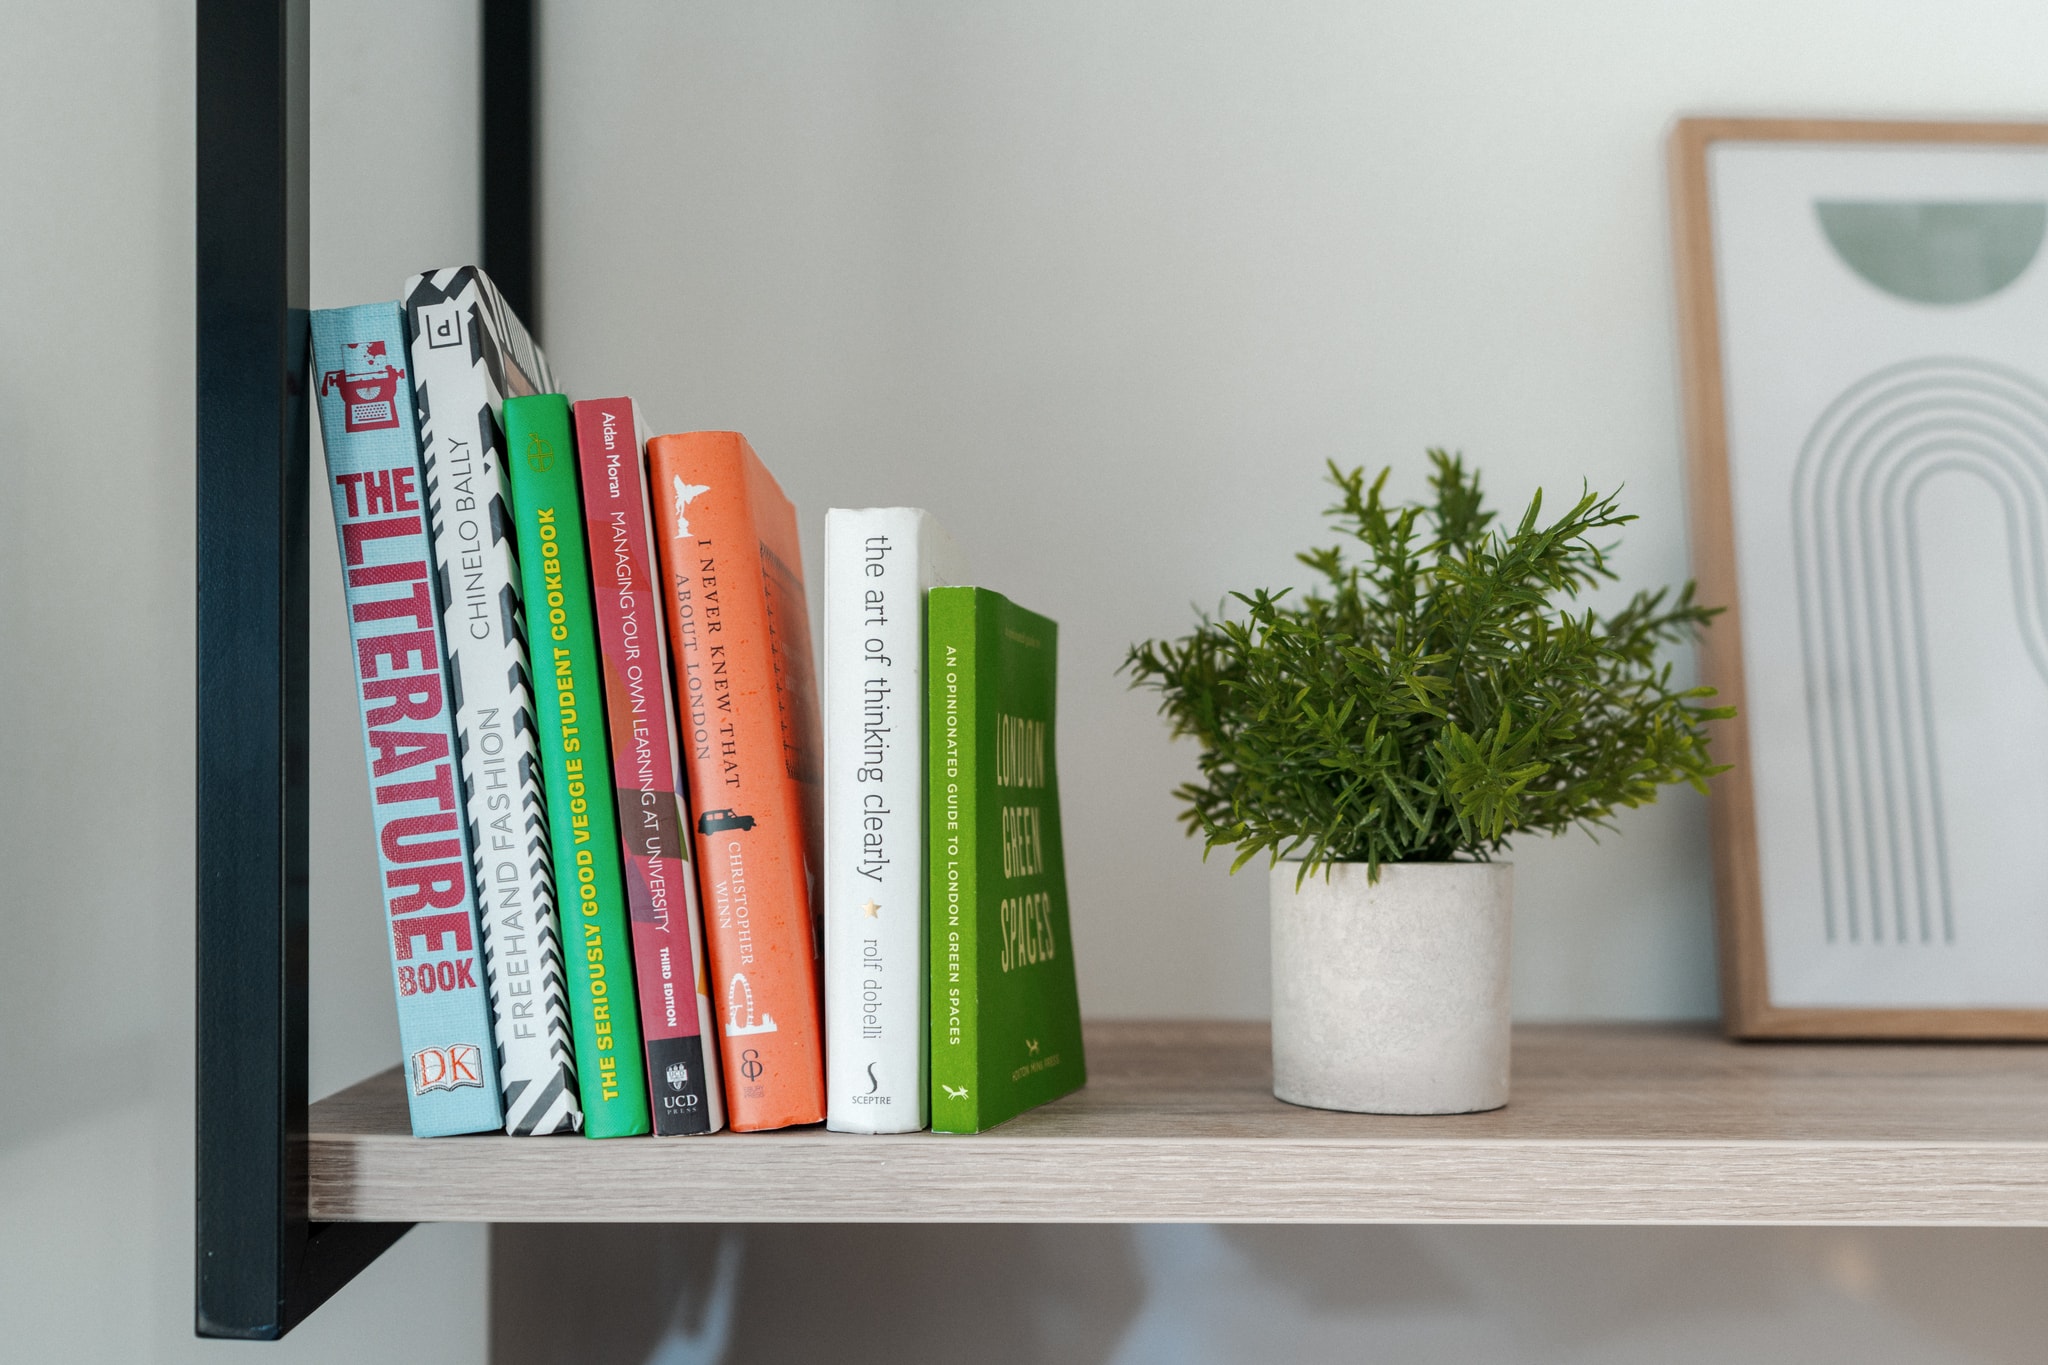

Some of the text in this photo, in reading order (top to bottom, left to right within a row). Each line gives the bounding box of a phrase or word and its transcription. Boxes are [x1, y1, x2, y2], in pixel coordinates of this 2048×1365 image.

[336, 467, 420, 519] THE
[602, 411, 620, 499] Aidan Moran
[447, 437, 490, 640] CHINELO BALLY
[675, 573, 711, 761] ABOUT LONDON
[698, 538, 741, 788] I NEVER KNEW THAT
[857, 535, 892, 883] the art of thinking clearly
[342, 515, 473, 961] LITERATURE
[610, 511, 670, 934] MANAGING YOUR OWN LEARNING AT UNIVERSITY
[996, 712, 1046, 789] LONDON
[537, 507, 619, 1102] THE SERIOUSLY GOOD VEGGIE STUDENT COOKBOOK
[946, 645, 960, 1046] AN OPINIONATED GUIDE TO LONDON GREEN SPACES
[1002, 805, 1044, 879] GREEN
[477, 706, 537, 1041] FREEHAND FASHION
[714, 881, 732, 929] WINN
[728, 841, 754, 966] CHRISTOPHER
[398, 957, 477, 997] BOOK
[1001, 891, 1055, 973] SPACES
[660, 946, 677, 1027] THIRD EDITION
[862, 939, 883, 1040] rolf dobelli
[418, 1046, 478, 1087] DK
[663, 1094, 698, 1108] UCD
[852, 1096, 891, 1105] SCEPTRE
